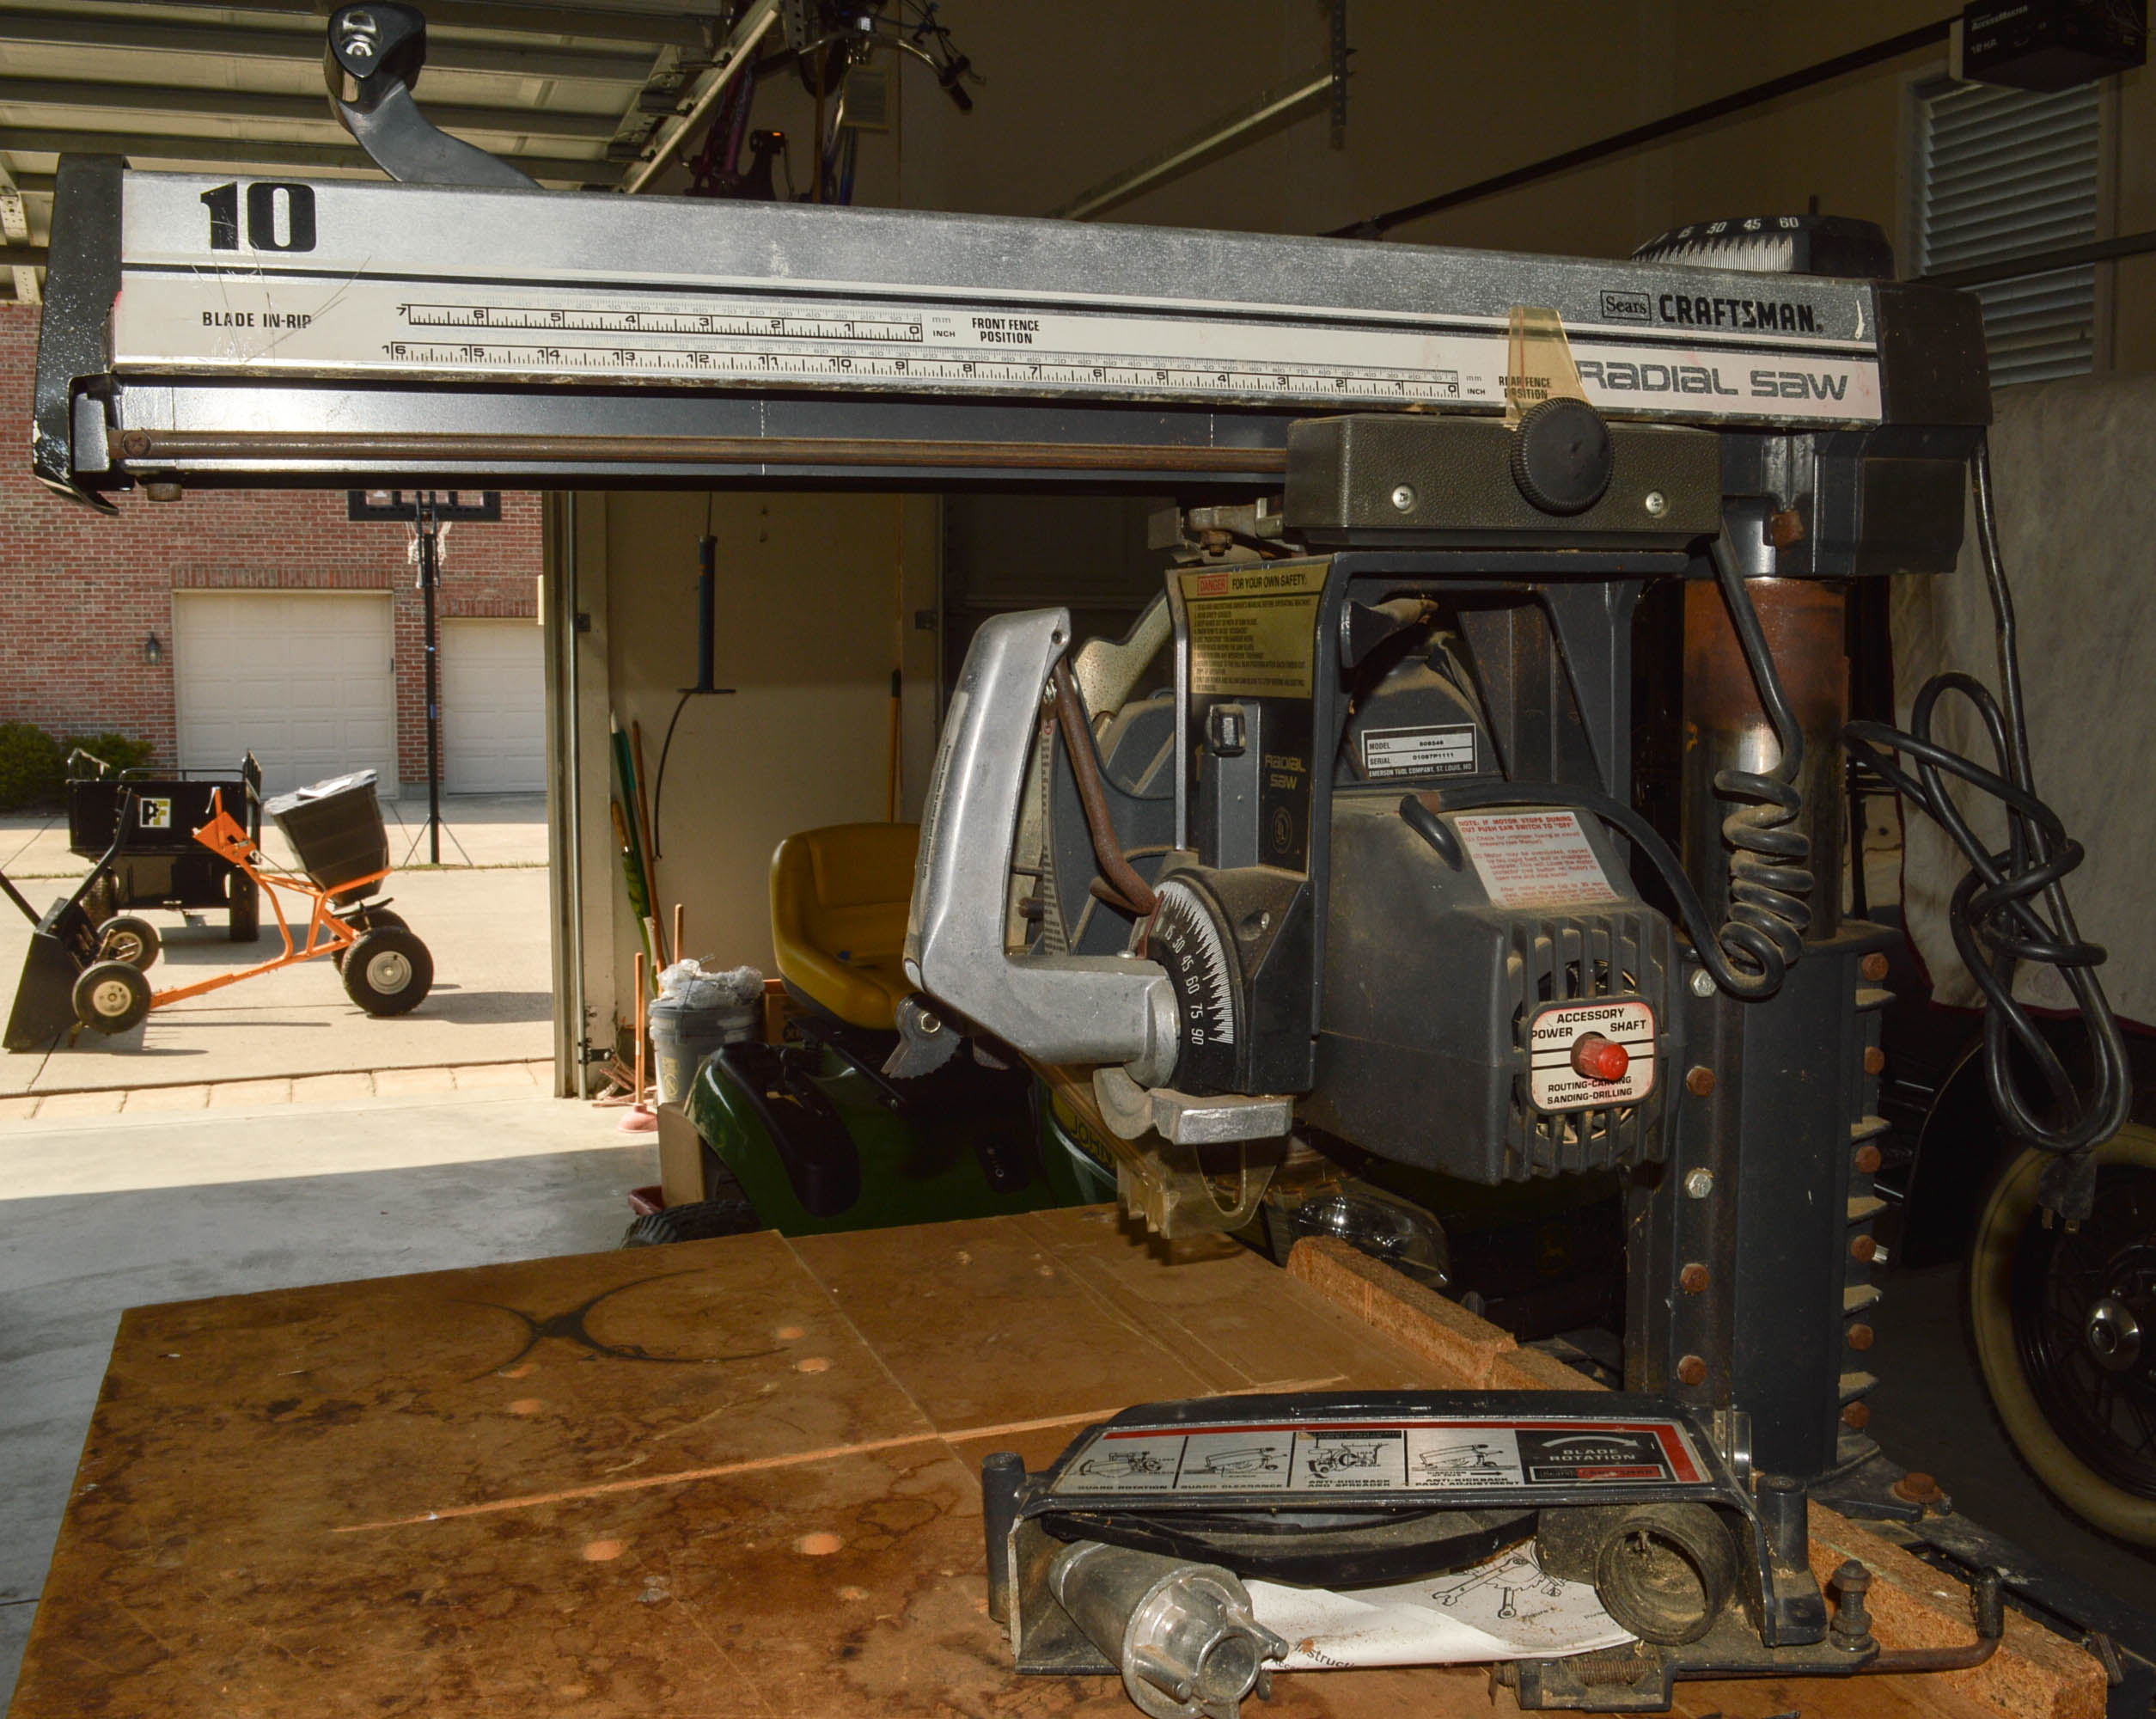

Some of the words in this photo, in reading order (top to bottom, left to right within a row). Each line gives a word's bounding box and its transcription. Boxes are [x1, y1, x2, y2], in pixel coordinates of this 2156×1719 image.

[200, 181, 316, 252] 10
[1707, 222, 1727, 234] 30
[1744, 218, 1762, 230] 45
[1779, 217, 1799, 229] 60
[1605, 295, 1647, 315] Sears
[202, 311, 255, 327] BLADE
[263, 313, 312, 328] IN-RIP
[396, 306, 407, 316] 7
[473, 310, 485, 319] 6
[551, 313, 562, 321] 5
[625, 315, 636, 324] 4
[699, 317, 710, 326] 3
[770, 320, 781, 329] 2
[844, 323, 852, 332] 1
[909, 326, 919, 334] 0
[971, 317, 1005, 330] FRONT
[1009, 319, 1040, 332] FENCE
[980, 331, 1033, 345] POSITION
[382, 345, 406, 355] 16
[460, 347, 485, 357] 15
[537, 349, 560, 359] 14
[612, 352, 636, 361] 13
[687, 353, 710, 364] 12
[758, 356, 779, 365] 11
[828, 358, 852, 367] 10
[895, 360, 906, 370] 9
[962, 364, 973, 372] 8
[1029, 366, 1038, 376] 7
[1092, 369, 1102, 377] 6
[1156, 371, 1165, 380] 5
[1217, 374, 1227, 382] 4
[1277, 376, 1286, 386] 3
[1335, 379, 1345, 388] 2
[1395, 382, 1402, 390] 1
[1448, 384, 1457, 393] 0
[1524, 377, 1552, 388] FENCE
[1200, 578, 1225, 593] DANGER
[1231, 578, 1244, 590] FOR
[1245, 577, 1262, 590] YOUR
[1263, 576, 1280, 589] OWN
[1368, 769, 1394, 778] EMERSON
[1164, 923, 1176, 941] 15
[1172, 934, 1186, 954] 30
[1182, 954, 1194, 973] 45
[1185, 976, 1200, 994] 60
[1189, 1003, 1204, 1019] 75
[1556, 1007, 1625, 1025] ACCESSORY
[1191, 1027, 1205, 1046] 90
[1531, 1027, 1573, 1040] POWER
[1609, 1019, 1647, 1032] SHAFT
[1547, 1087, 1633, 1104] SANDING-DRILLING
[1548, 1453, 1636, 1462] ROTATION
